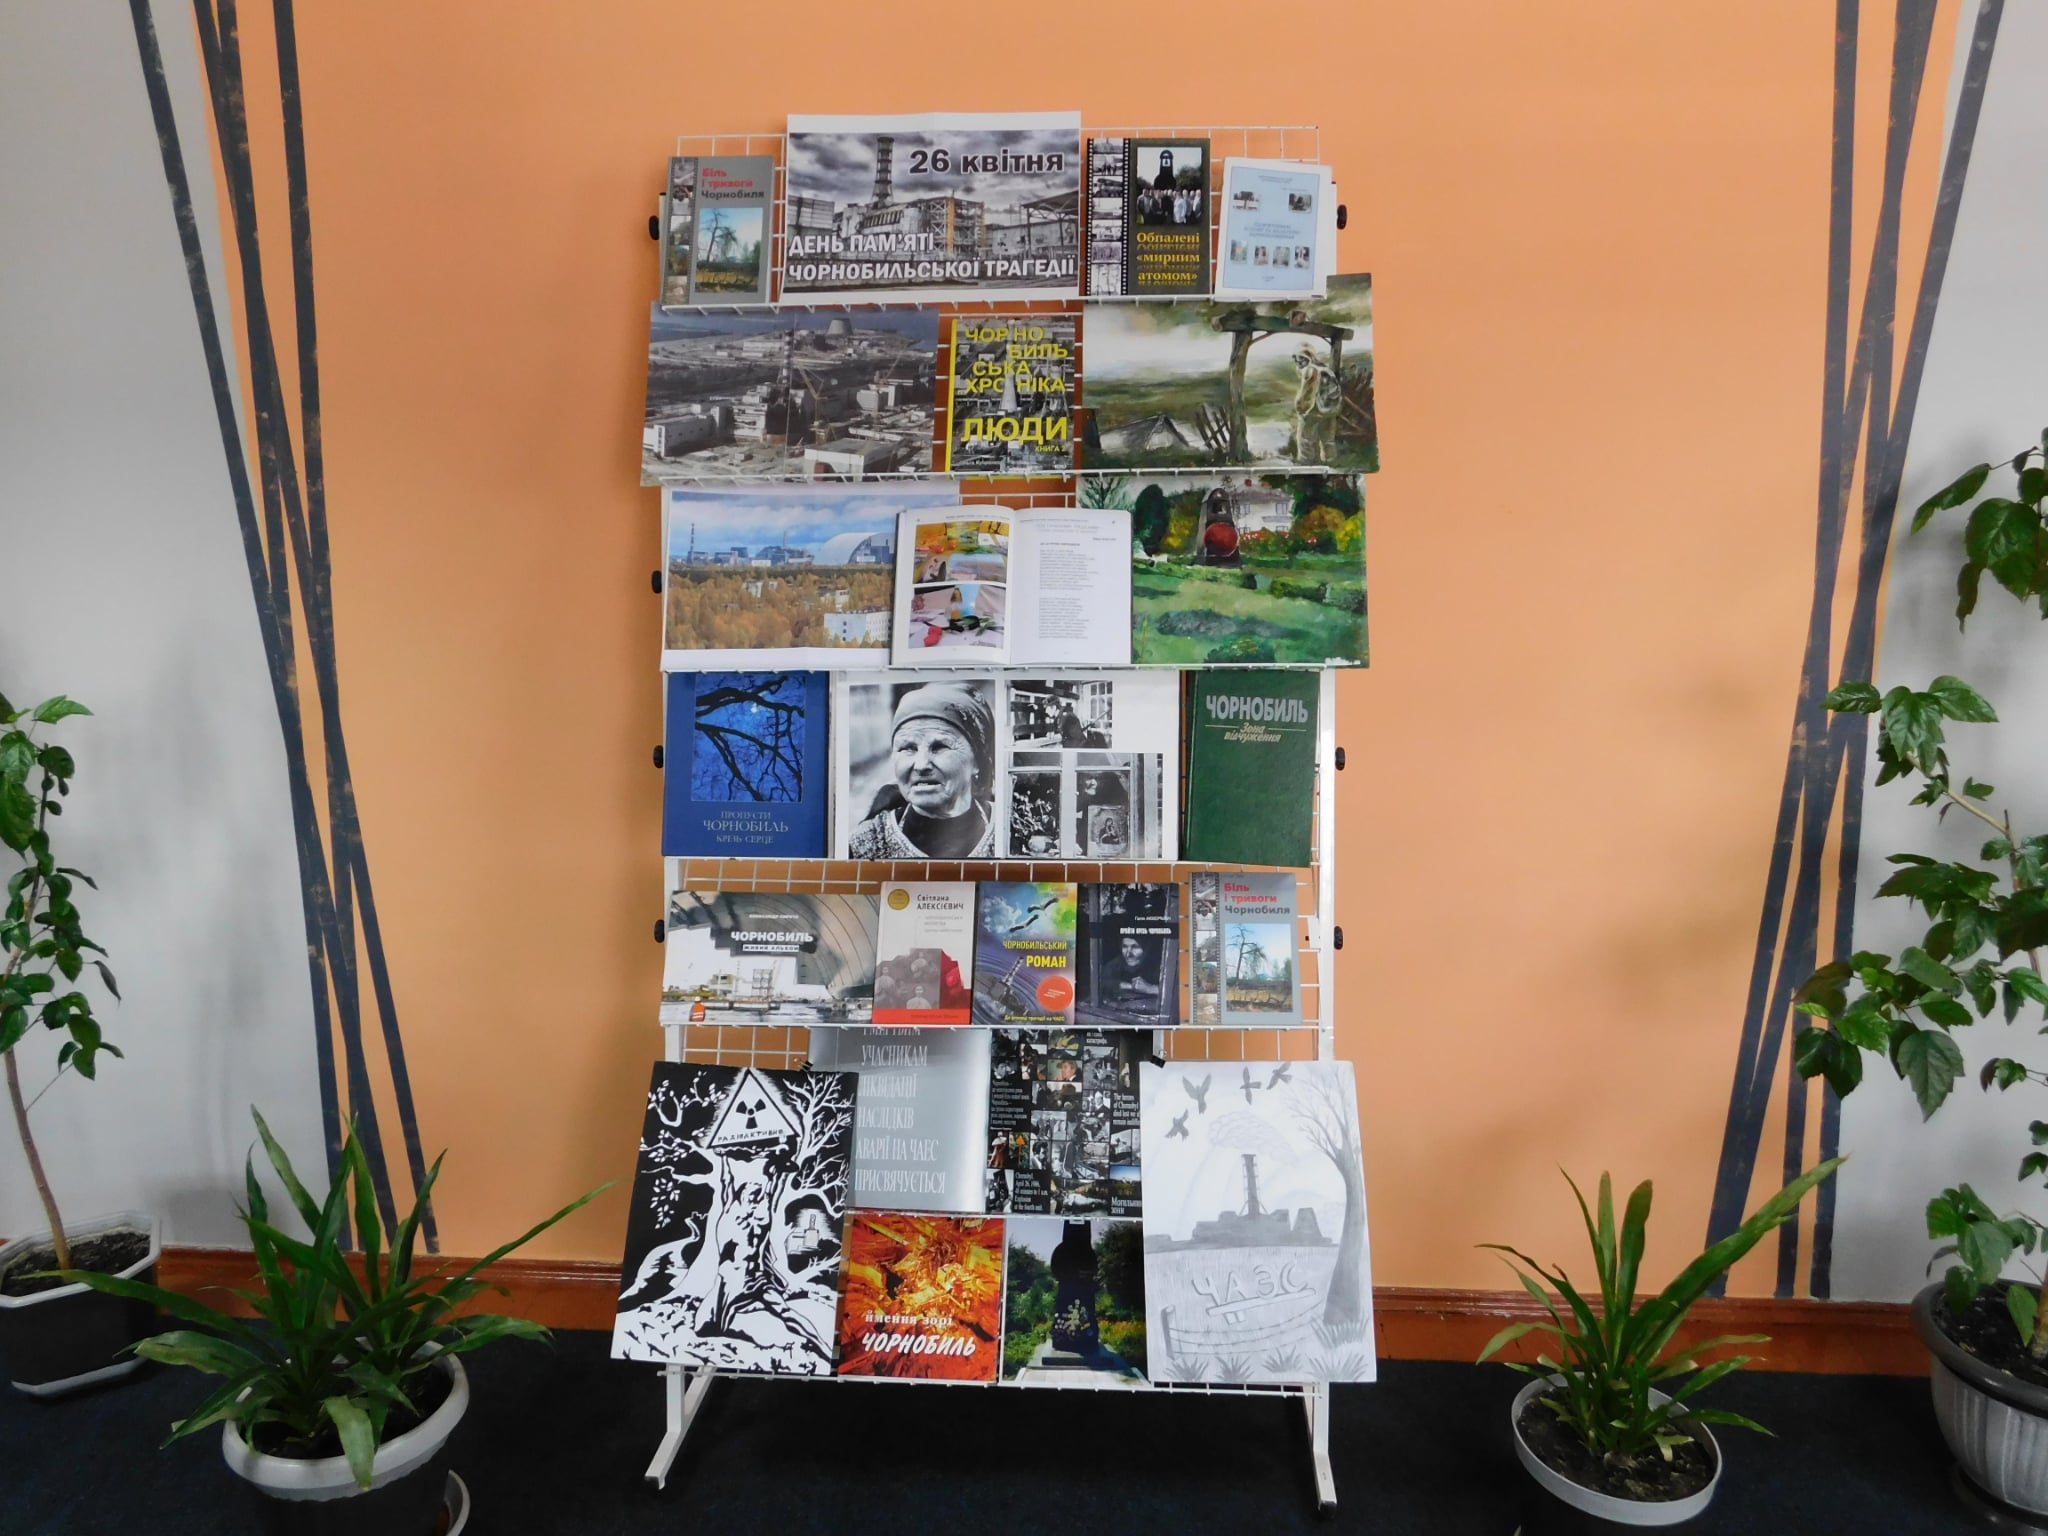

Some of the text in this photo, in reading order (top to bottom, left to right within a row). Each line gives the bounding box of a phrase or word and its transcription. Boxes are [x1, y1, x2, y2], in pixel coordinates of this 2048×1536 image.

[909, 149, 1064, 174] 26 квітня
[702, 167, 728, 177] Біль
[708, 180, 754, 190] тривоги
[701, 190, 765, 201] Чорнобиля
[1136, 232, 1201, 244] Обпалені
[788, 234, 845, 256] ДЕНЬ
[1136, 252, 1201, 264] «мирним
[788, 254, 1075, 281] ЧОРНОБИЛЬСЬКОЇ ТРАГЕДІЇ
[1137, 272, 1198, 281] атомом»
[1008, 343, 1069, 359] БИЛЬ
[972, 360, 1032, 376] СЬКА
[960, 417, 1068, 446] ЛЮДИ
[1206, 695, 1308, 723] ЧОРНОБИЛЬ
[1239, 722, 1266, 733] Зона
[1223, 729, 1282, 743] відчуження
[720, 810, 772, 820] ПРОПУСТИ
[703, 820, 789, 833] ЧОРНОБИЛЬ
[744, 835, 774, 845] СЕРЦЕ
[1224, 883, 1250, 892] Біль
[916, 894, 950, 902] Світлана
[1231, 894, 1278, 904] тривоги
[916, 902, 965, 911] АЛЕКСІЄВИЧ
[1225, 905, 1291, 916] Чорнобиля
[730, 931, 814, 943] ЧОРНОБИЛЬ
[1003, 939, 1068, 951] ЧОРНОБИЛЬСЬКИЙ
[1026, 955, 1067, 968] РОМАН
[861, 1044, 928, 1067] УЧАСНИКАМ
[857, 1107, 914, 1132] НАСЛІДКІВ
[855, 1134, 939, 1162] АВАРІЇ НА ЧАЕС
[854, 1168, 946, 1194] ПРИСВЯЧУЄТЬСЯ
[922, 1314, 954, 1329] зорі
[862, 1332, 976, 1357] ЧОРНОБИЛЬ
